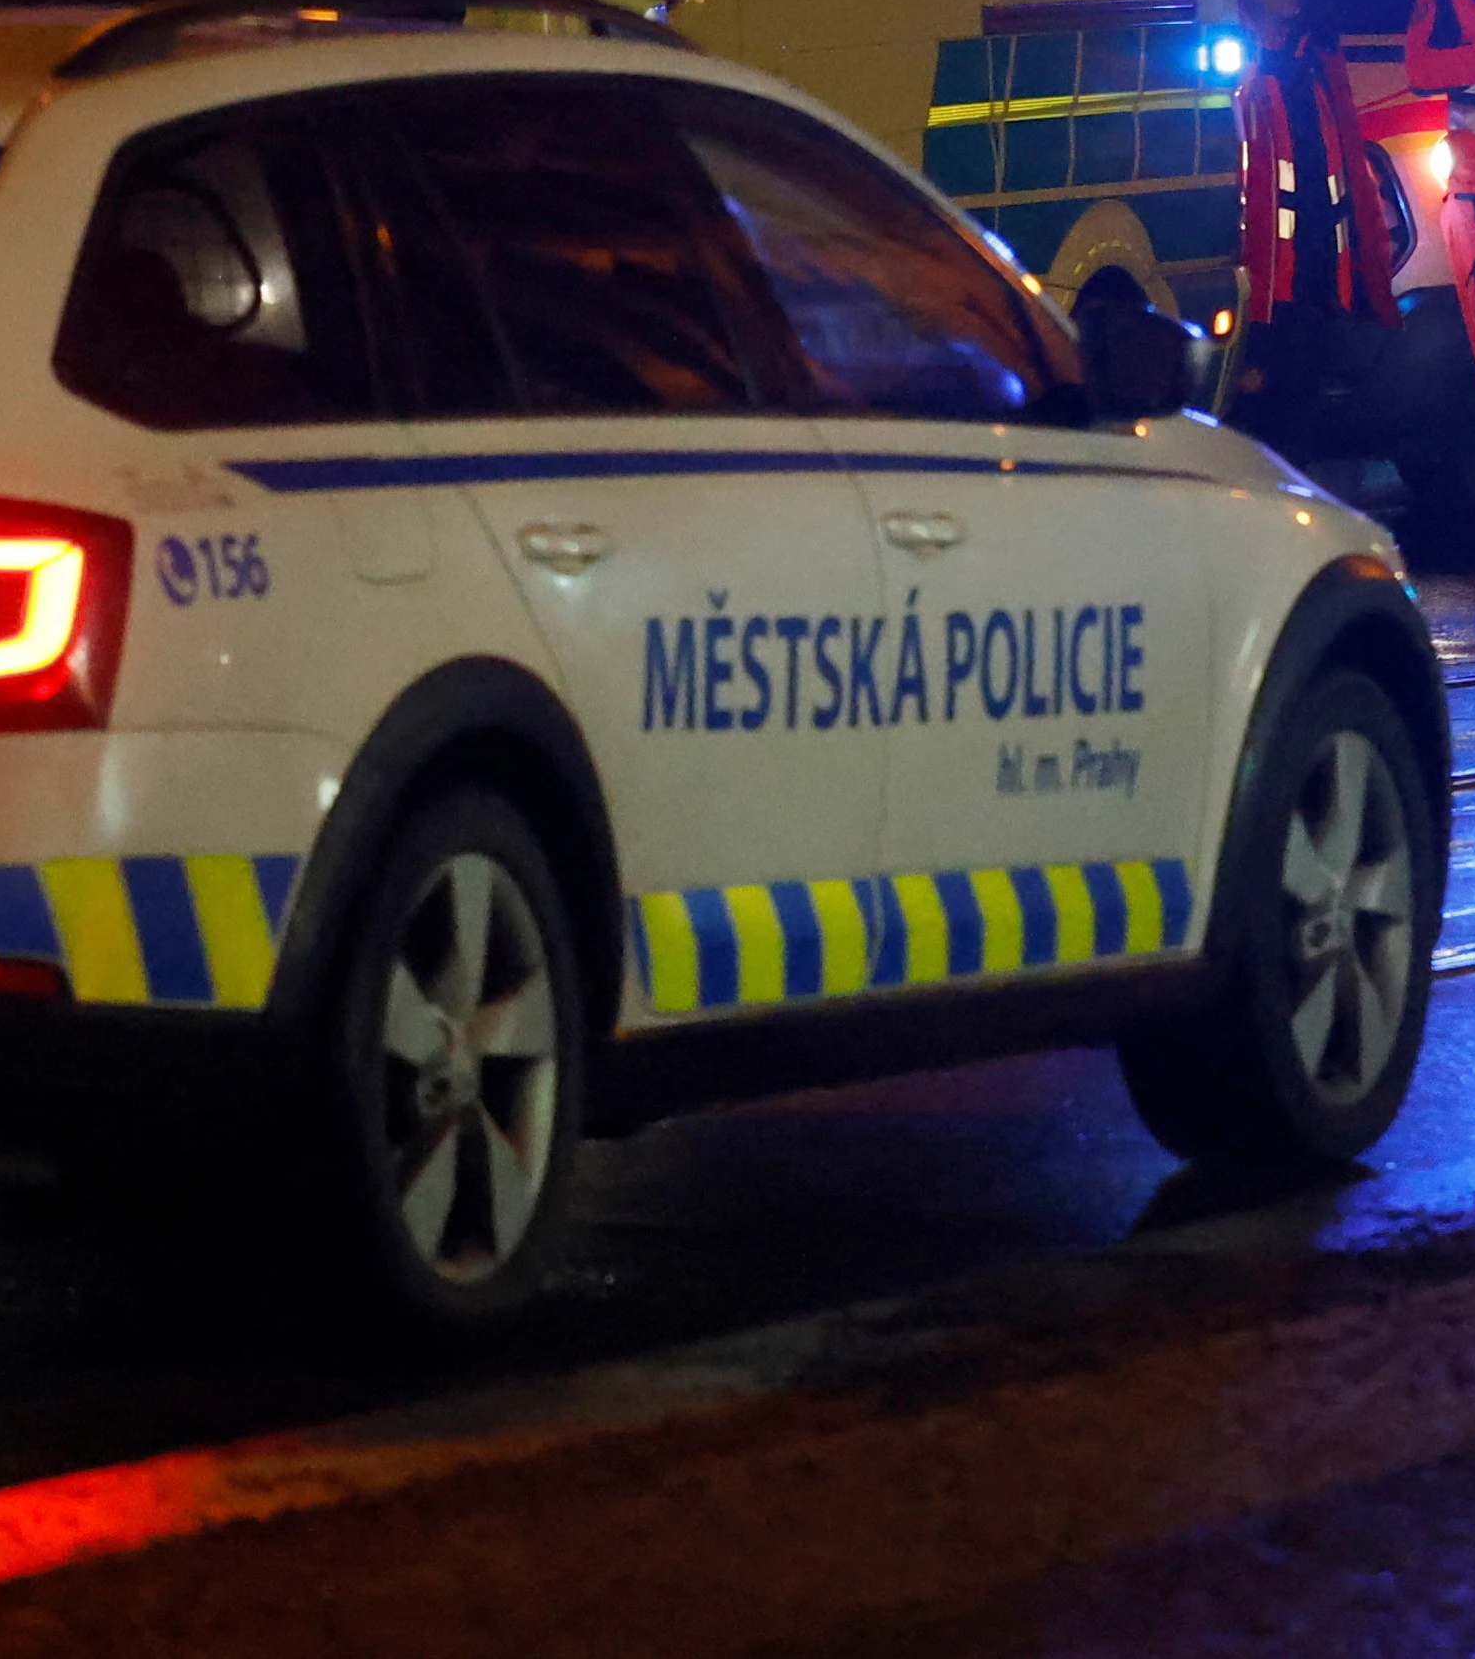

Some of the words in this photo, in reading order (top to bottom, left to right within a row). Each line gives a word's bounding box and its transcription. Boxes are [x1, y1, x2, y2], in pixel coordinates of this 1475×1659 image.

[198, 533, 271, 599] 156
[642, 587, 929, 733] MĚSTSKÁ
[943, 602, 1146, 723] POLICIE
[1071, 738, 1141, 800] Prahy
